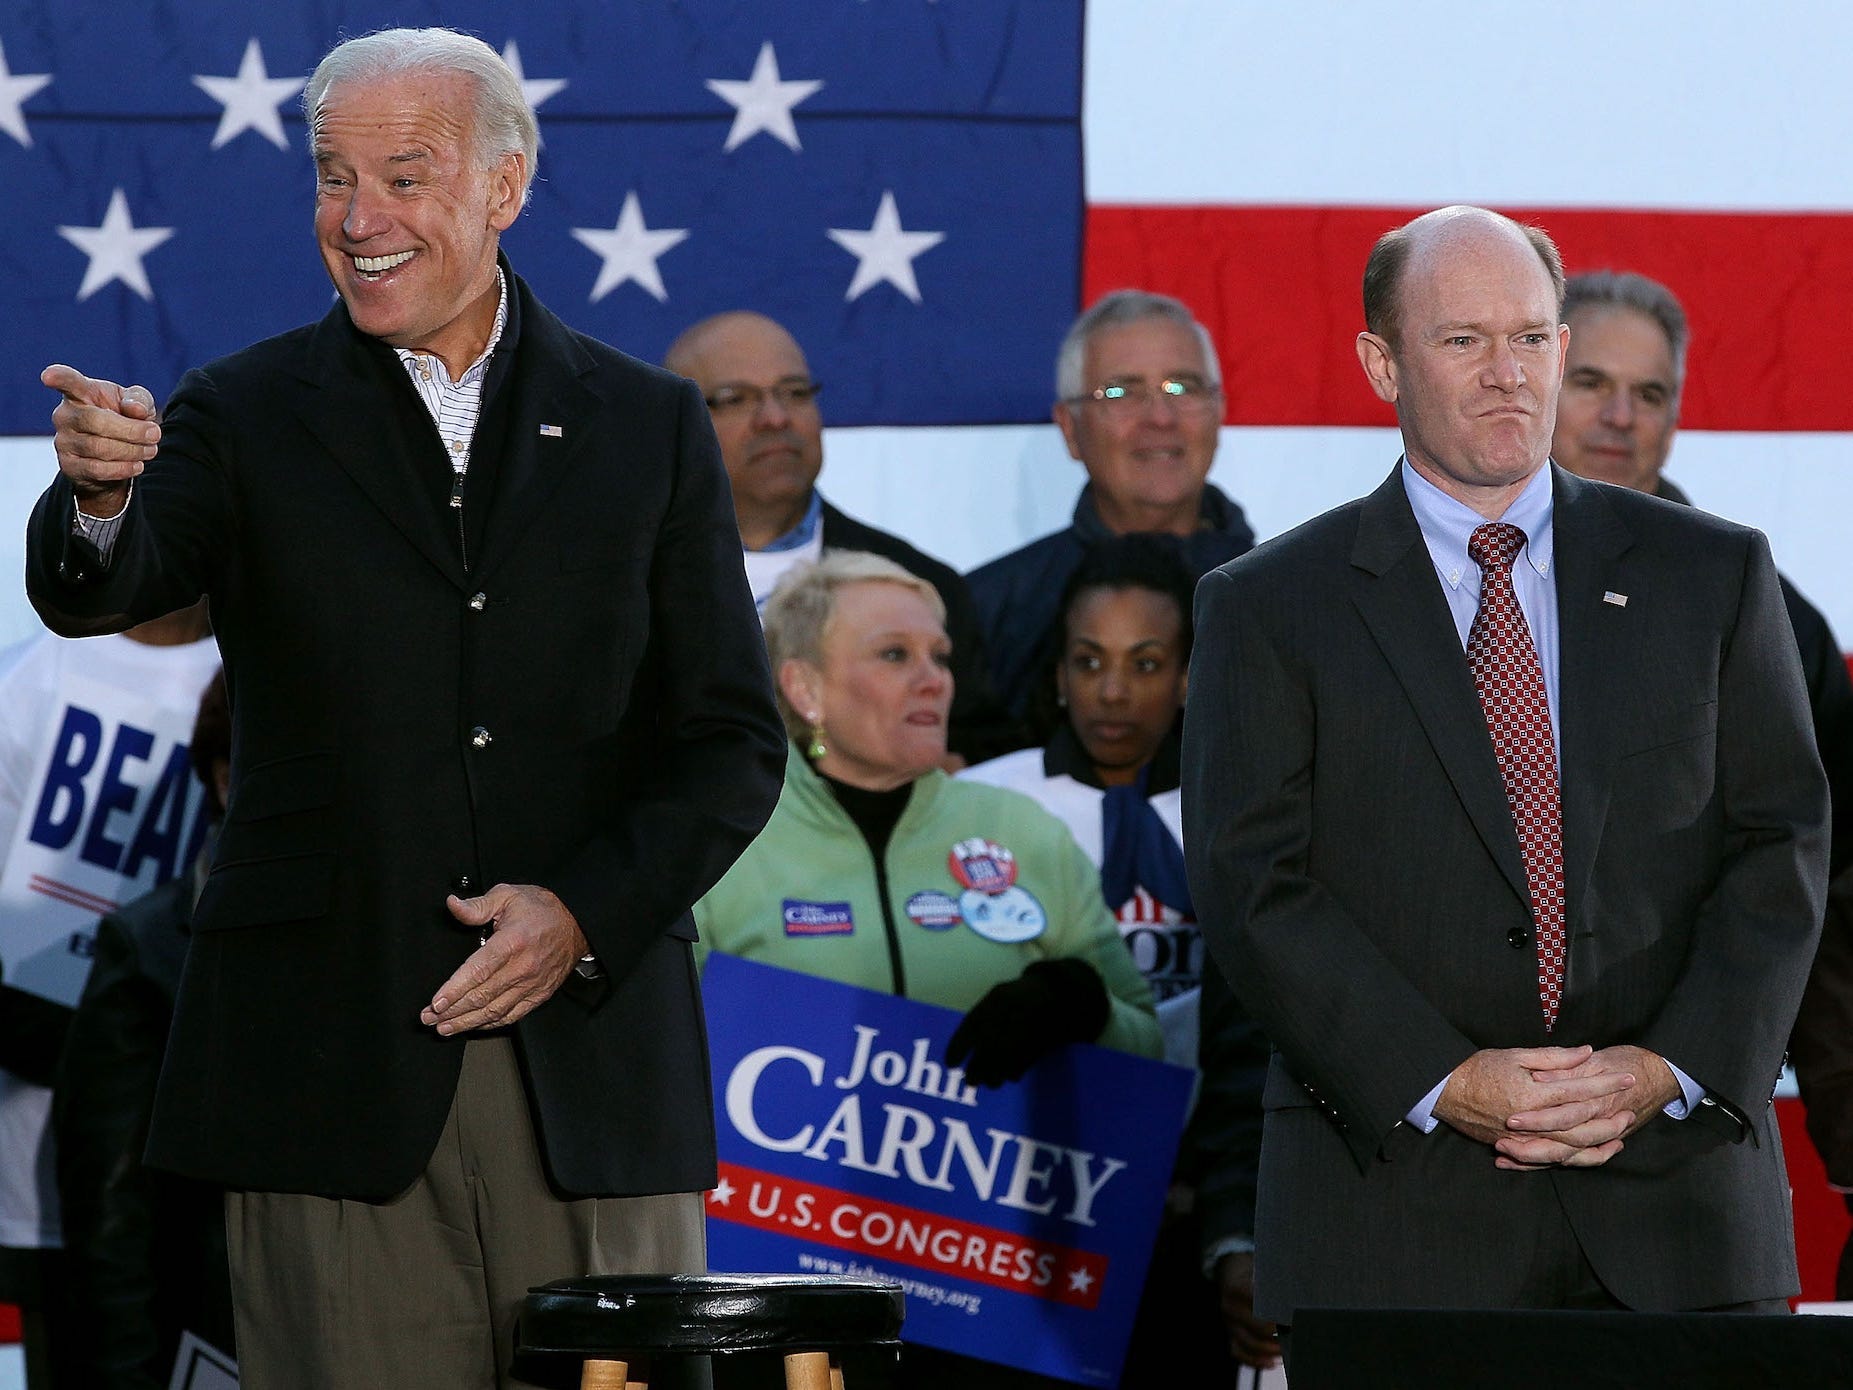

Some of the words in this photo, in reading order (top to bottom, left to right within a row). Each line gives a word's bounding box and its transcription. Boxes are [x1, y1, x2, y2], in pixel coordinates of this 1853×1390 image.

[725, 1045, 1128, 1228] CARNEY
[748, 1182, 824, 1232] U.S.
[828, 1203, 1057, 1286] CONGRESS
